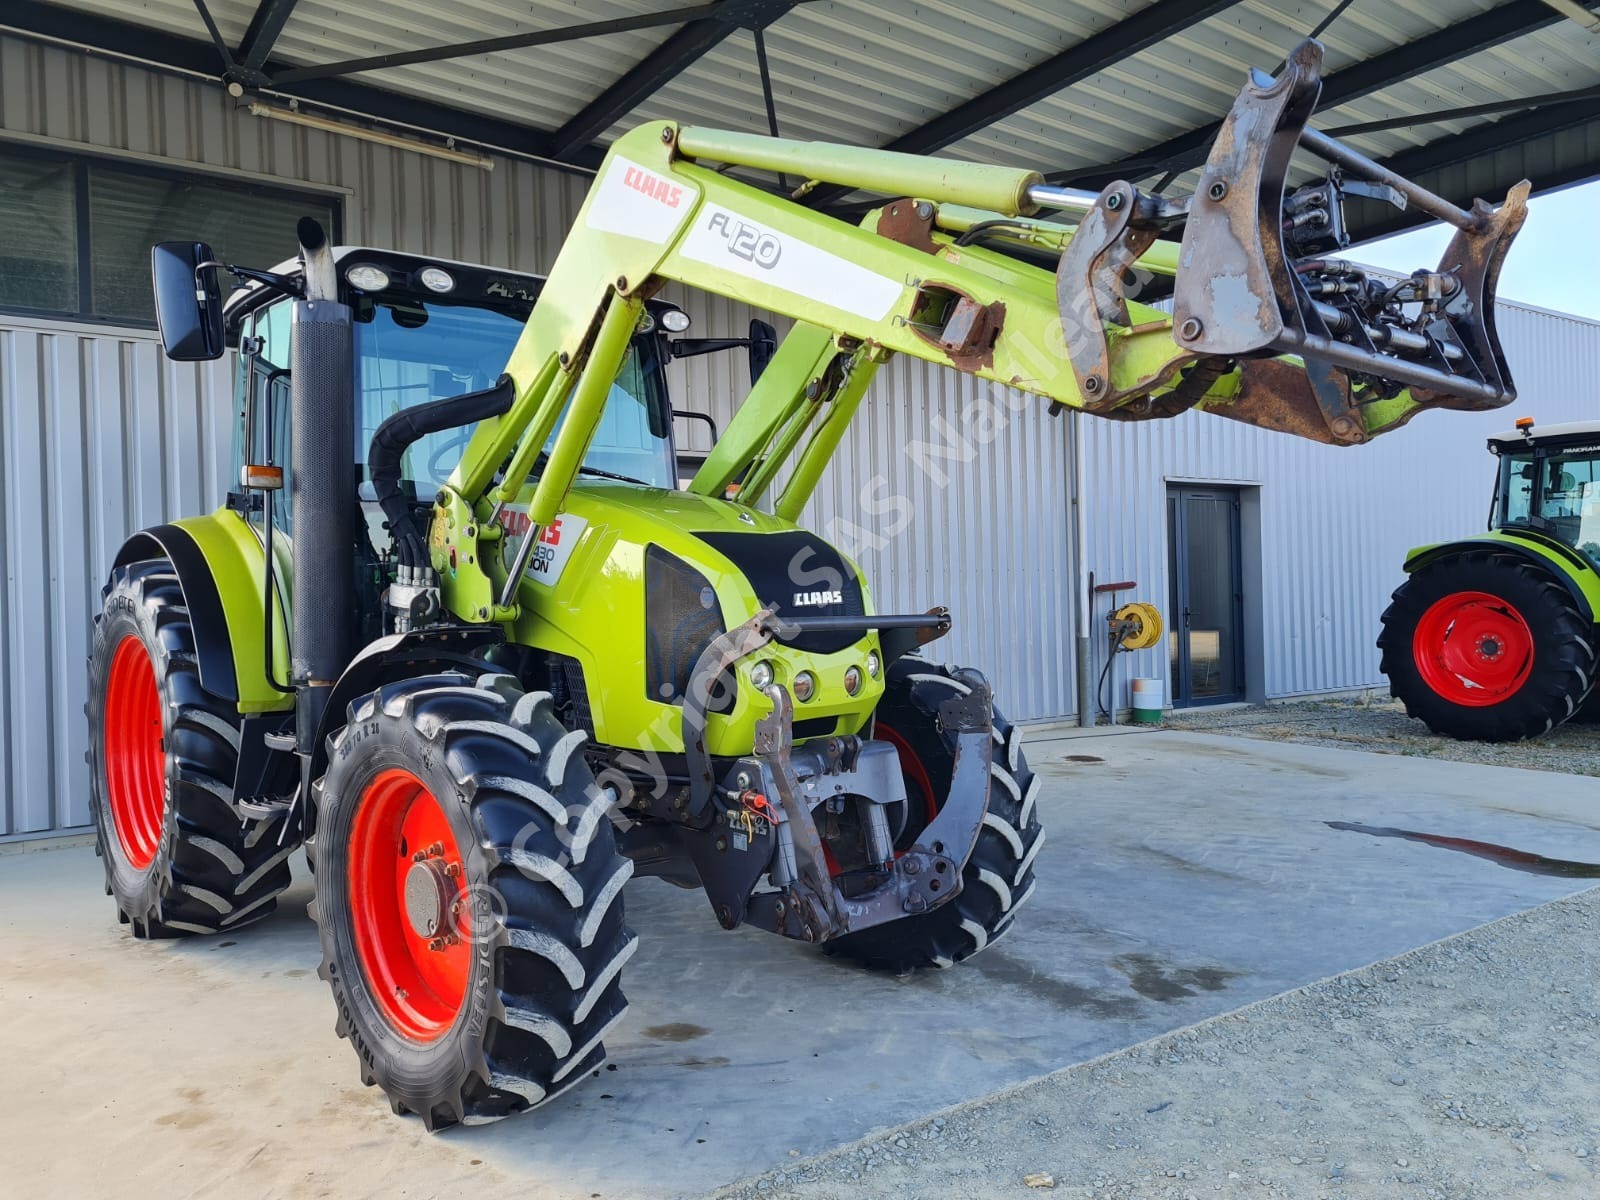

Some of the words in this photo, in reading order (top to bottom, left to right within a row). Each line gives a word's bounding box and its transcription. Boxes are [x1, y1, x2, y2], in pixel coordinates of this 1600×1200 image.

[624, 167, 682, 208] CLAAS
[500, 509, 563, 546] CLAS
[793, 590, 843, 607] CLAAS
[329, 962, 340, 985] 70
[337, 990, 376, 1070] TRAXION
